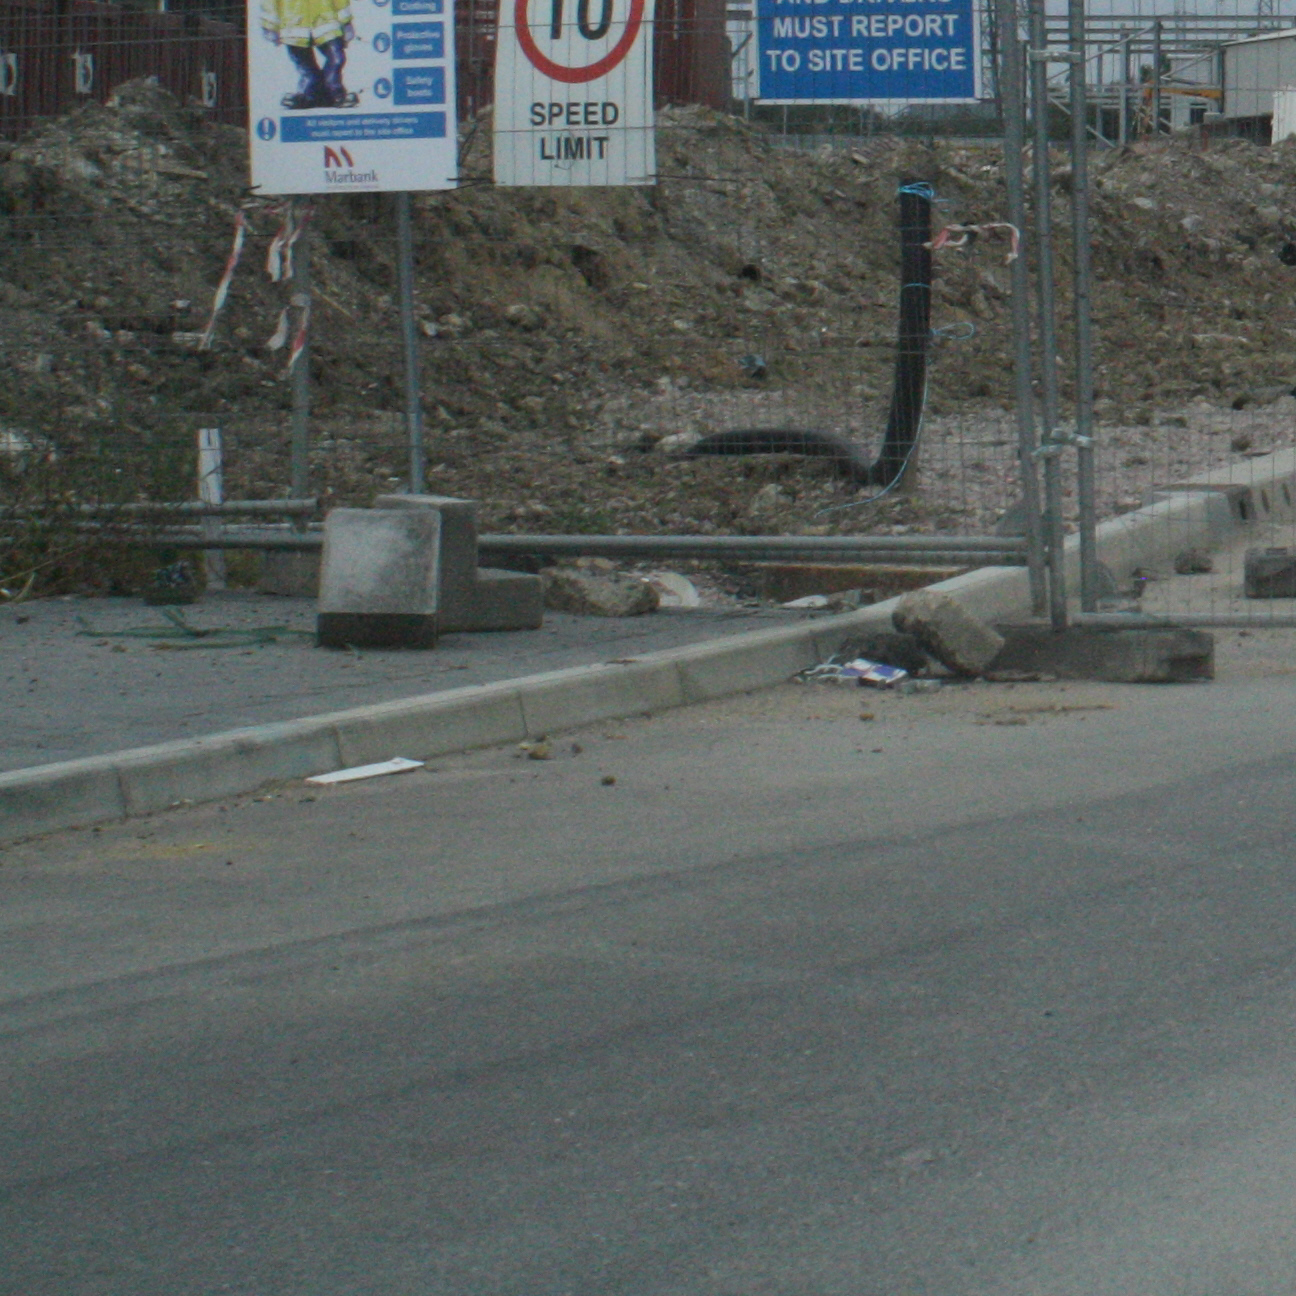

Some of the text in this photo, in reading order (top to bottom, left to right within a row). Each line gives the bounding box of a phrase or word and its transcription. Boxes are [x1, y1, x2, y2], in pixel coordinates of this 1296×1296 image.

[772, 14, 959, 38] MUST REPORT
[766, 47, 967, 72] TO SITE OFFICE
[529, 101, 619, 126] SPEED
[540, 136, 609, 161] LIMIT
[325, 170, 379, 183] Marbank
